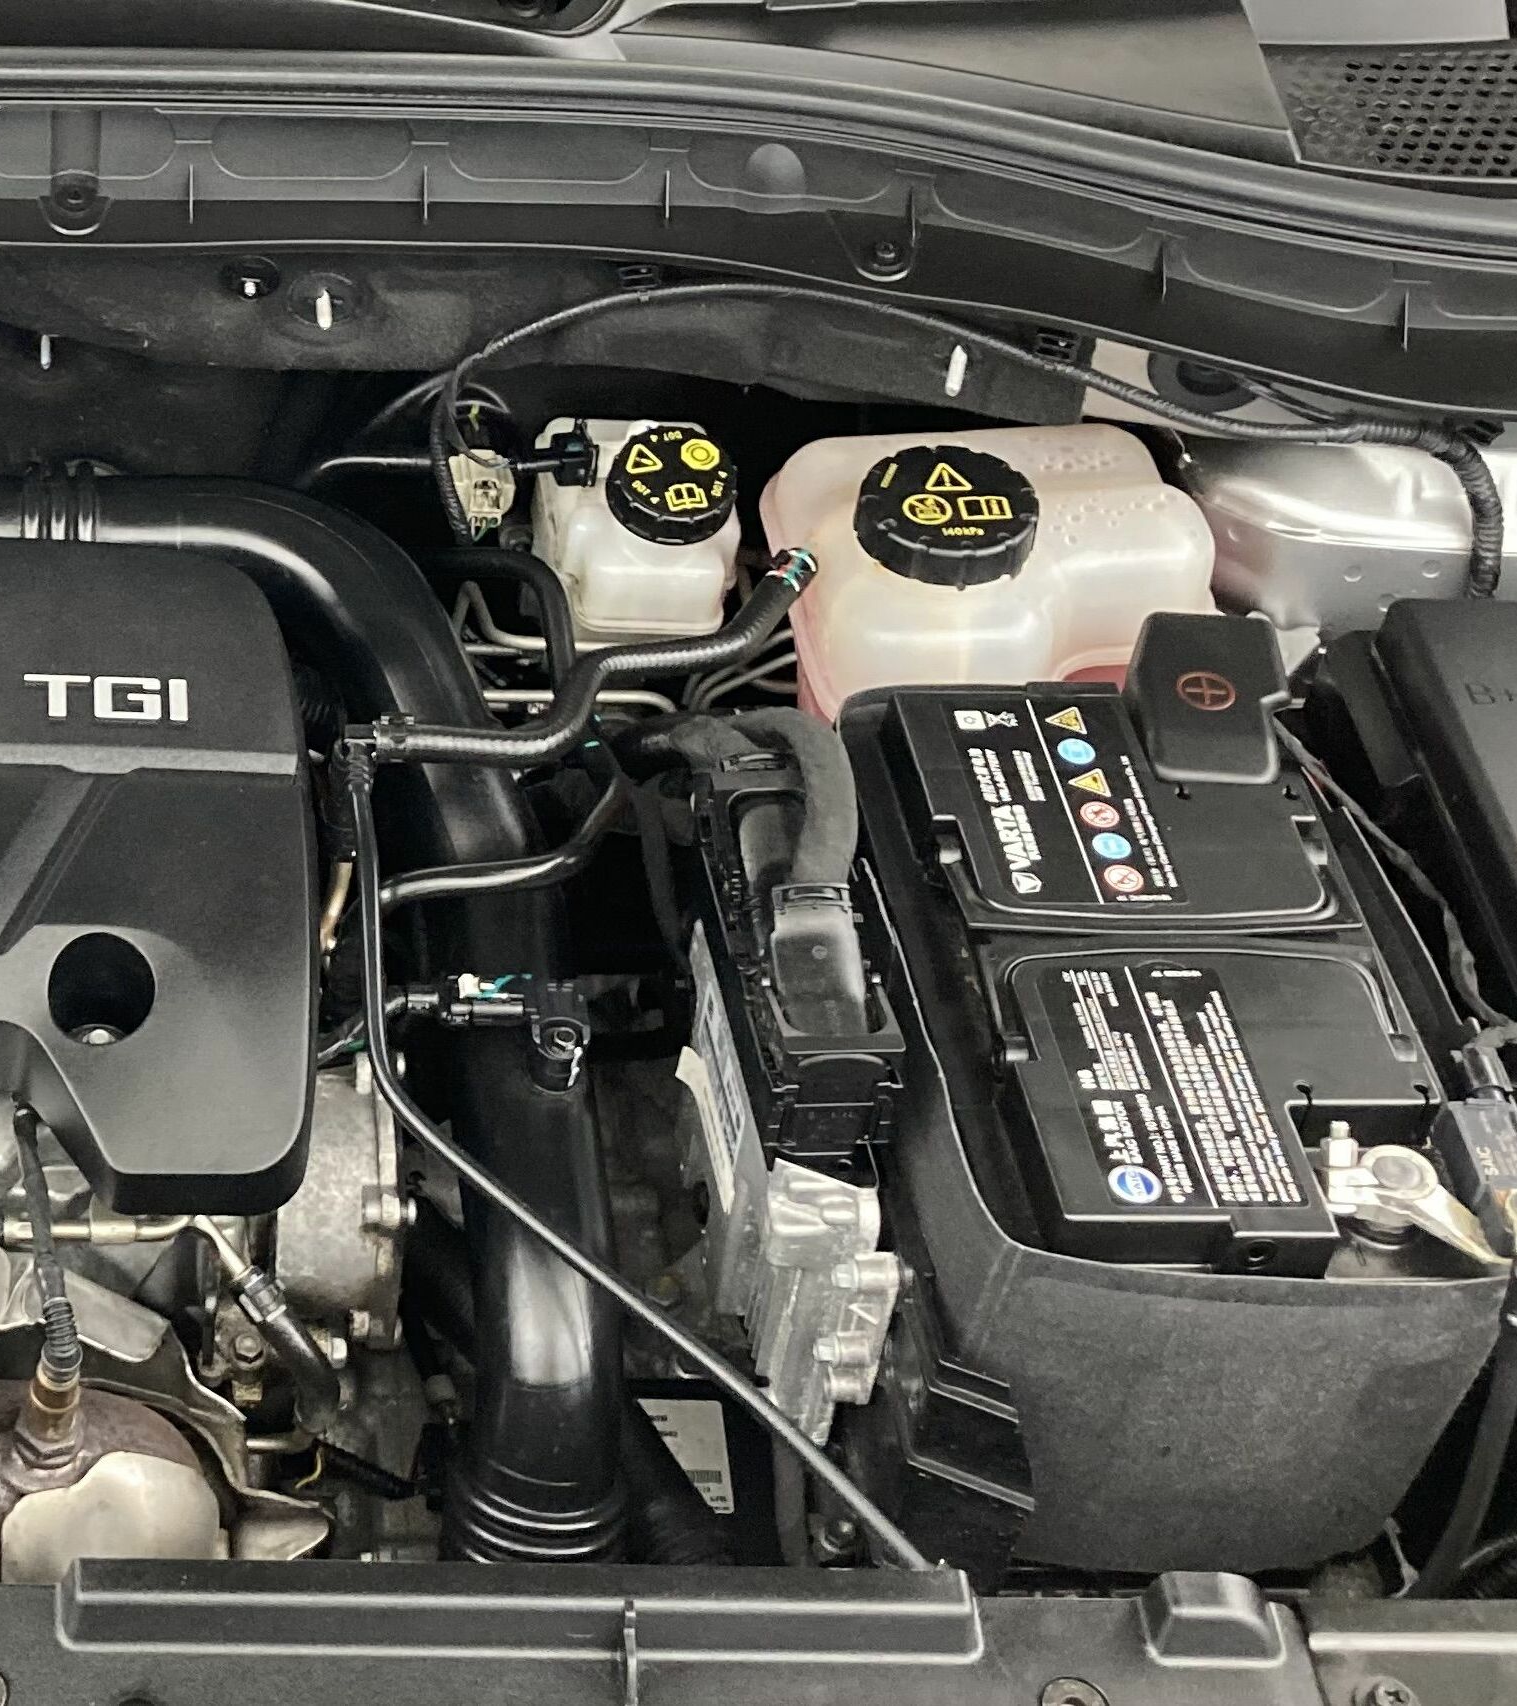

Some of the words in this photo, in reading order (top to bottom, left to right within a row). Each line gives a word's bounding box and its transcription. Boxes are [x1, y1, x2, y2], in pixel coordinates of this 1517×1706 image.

[23, 673, 189, 722] TGI
[991, 804, 1032, 871] VARTA
[1112, 1100, 1135, 1138] MOTOR
[1475, 1146, 1499, 1175] SAIC
